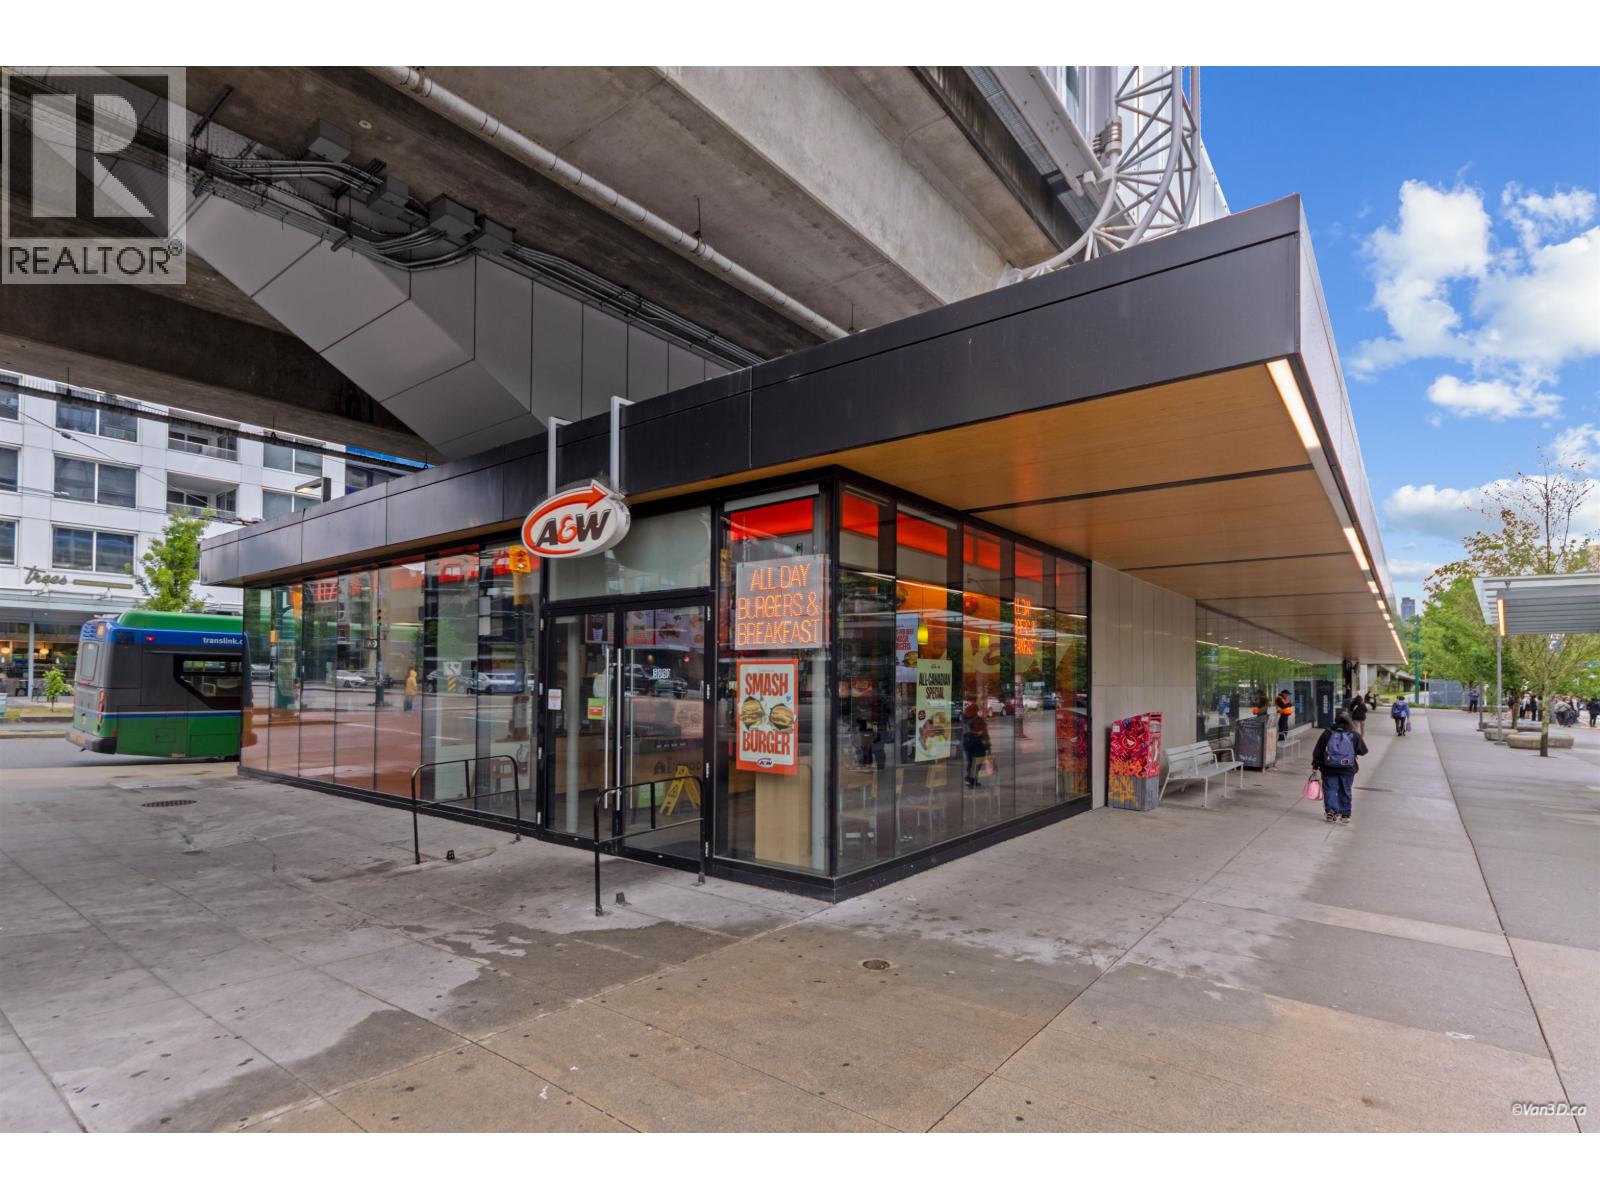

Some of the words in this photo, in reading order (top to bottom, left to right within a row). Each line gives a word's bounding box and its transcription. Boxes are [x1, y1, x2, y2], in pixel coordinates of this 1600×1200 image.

[536, 509, 611, 546] A&W
[750, 567, 776, 591] ALL
[780, 562, 811, 589] DAY
[736, 593, 803, 620] BURGERS
[807, 592, 820, 616] &
[736, 619, 818, 646] BREAKFAST
[745, 672, 789, 697] SMASH
[919, 672, 951, 687] ALL-CANADIAN
[926, 686, 944, 699] SPECIAL
[742, 730, 790, 755] BURGER
